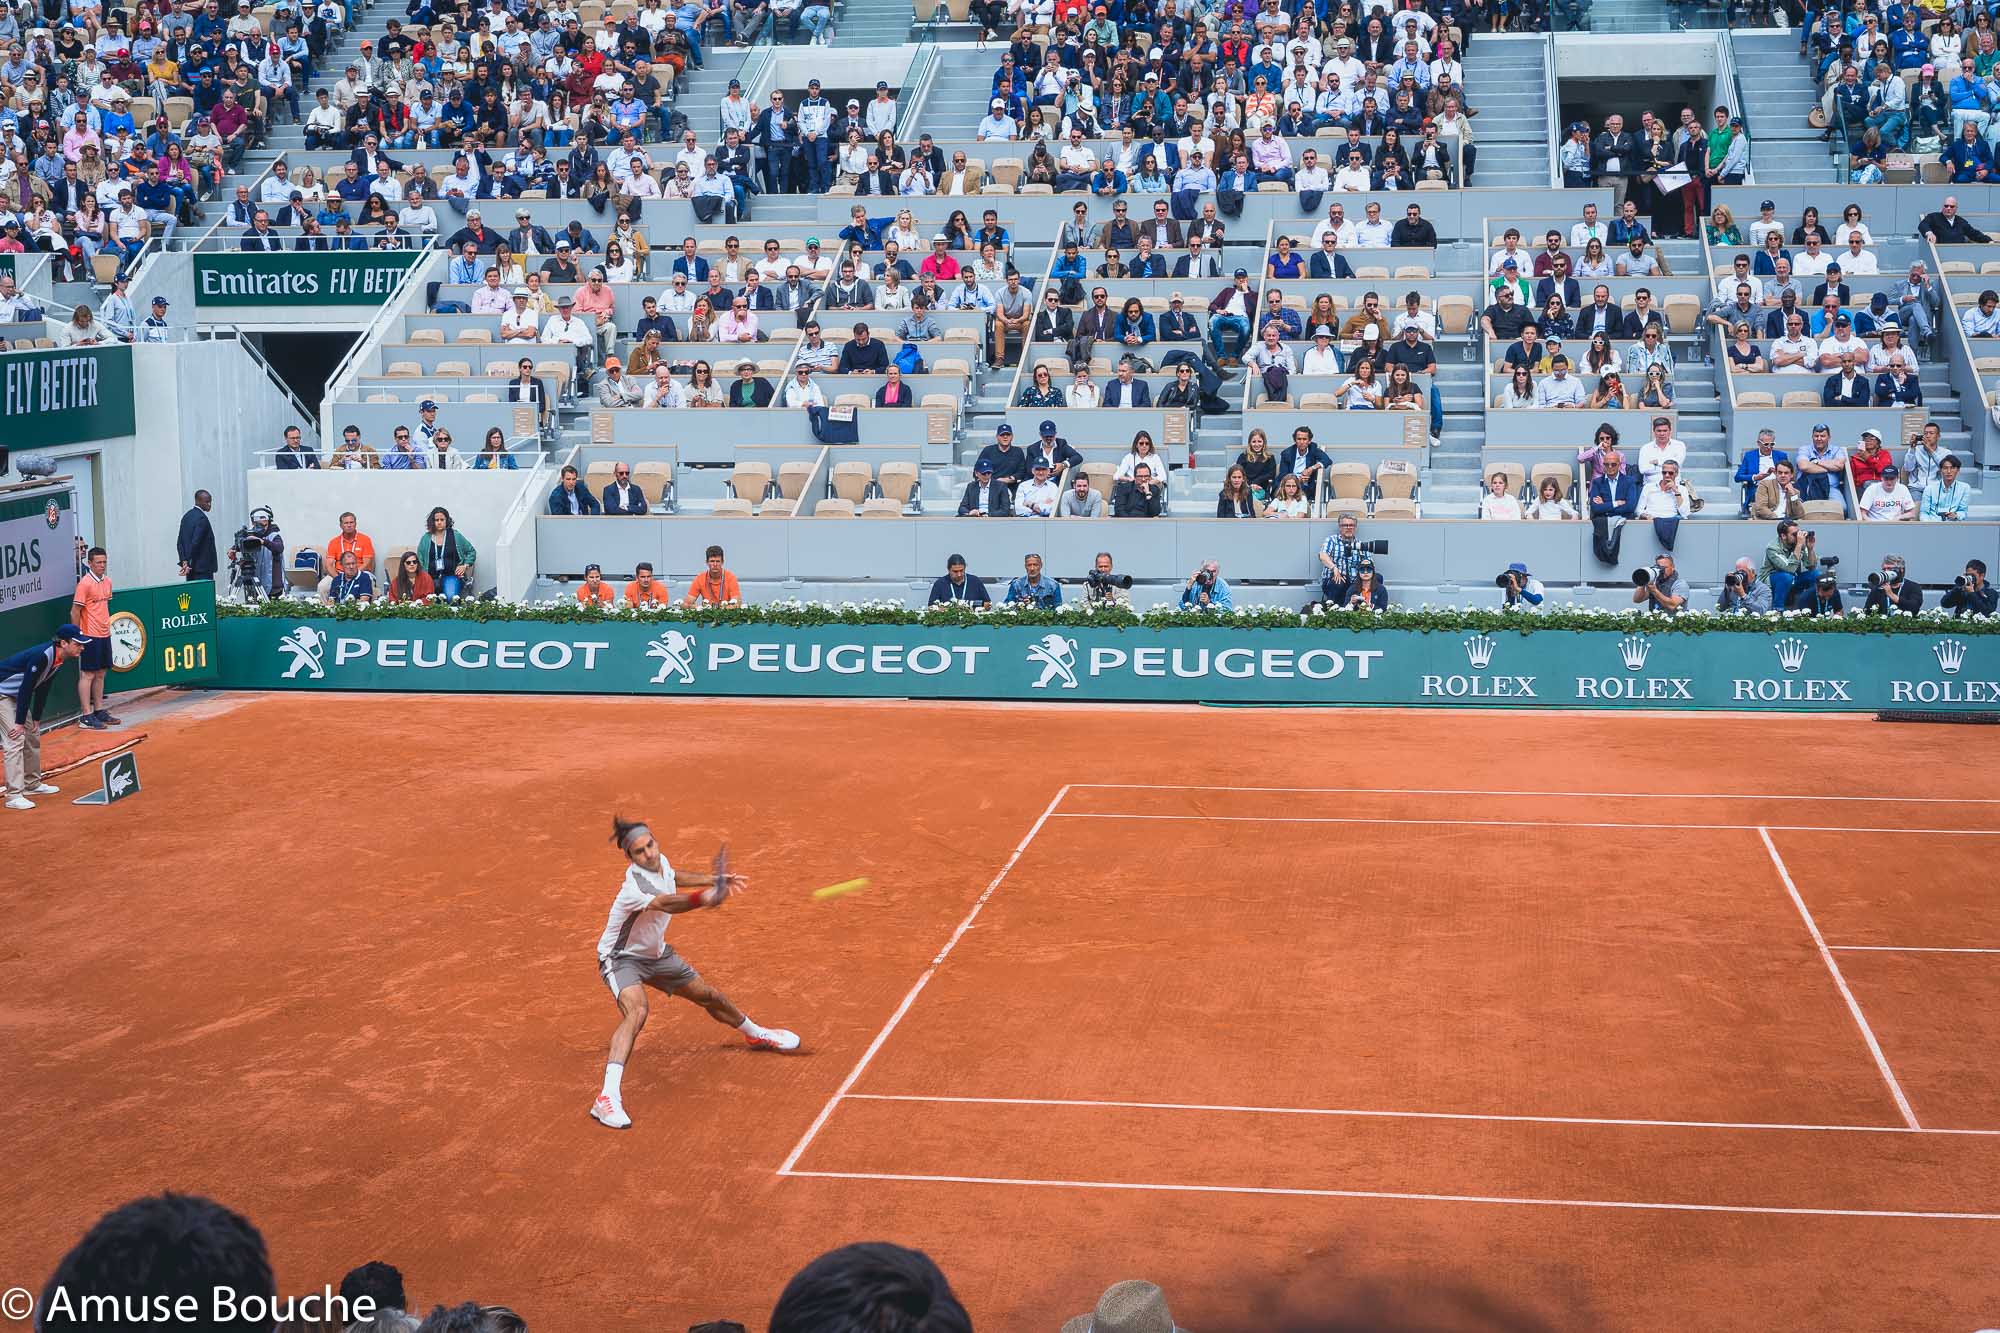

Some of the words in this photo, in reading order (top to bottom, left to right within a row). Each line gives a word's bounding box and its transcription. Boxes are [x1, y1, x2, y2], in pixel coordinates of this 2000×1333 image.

[201, 268, 319, 295] Emirates
[329, 268, 359, 294] FLY
[6, 362, 34, 415] FLY
[40, 357, 98, 412] BETTER
[18, 576, 42, 595] world
[161, 612, 208, 630] ROLEX
[164, 642, 207, 673] 0:01
[335, 638, 610, 670] PEUGEOT
[707, 643, 990, 674] PEUGEOT
[1089, 647, 1384, 679] PEUGEOT
[1421, 675, 1538, 697] ROLEX
[1575, 677, 1694, 699] ROLEX
[1732, 679, 1852, 701] ROLEX
